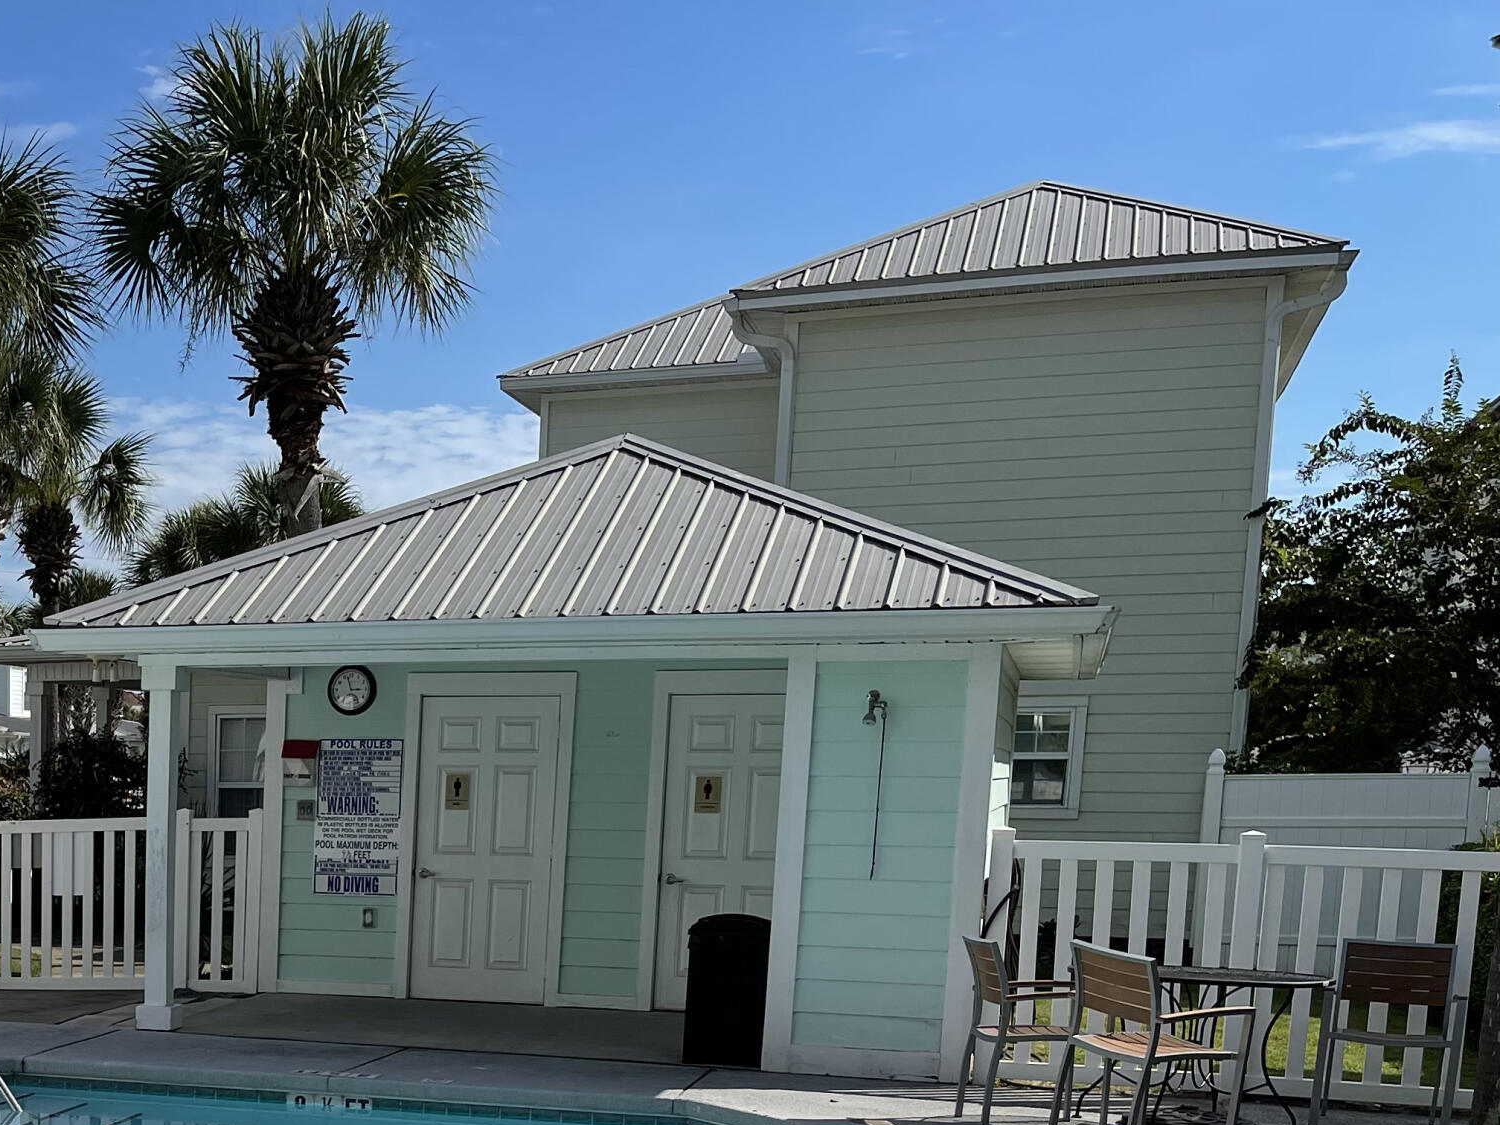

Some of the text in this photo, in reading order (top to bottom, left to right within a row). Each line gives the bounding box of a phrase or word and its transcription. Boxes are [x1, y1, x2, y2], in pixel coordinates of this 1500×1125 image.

[330, 740, 392, 749] POOL RULES
[315, 840, 335, 849] POOL
[337, 840, 371, 850] MAXIMUM
[354, 851, 371, 860] FEET
[328, 876, 379, 893] NO DIVING
